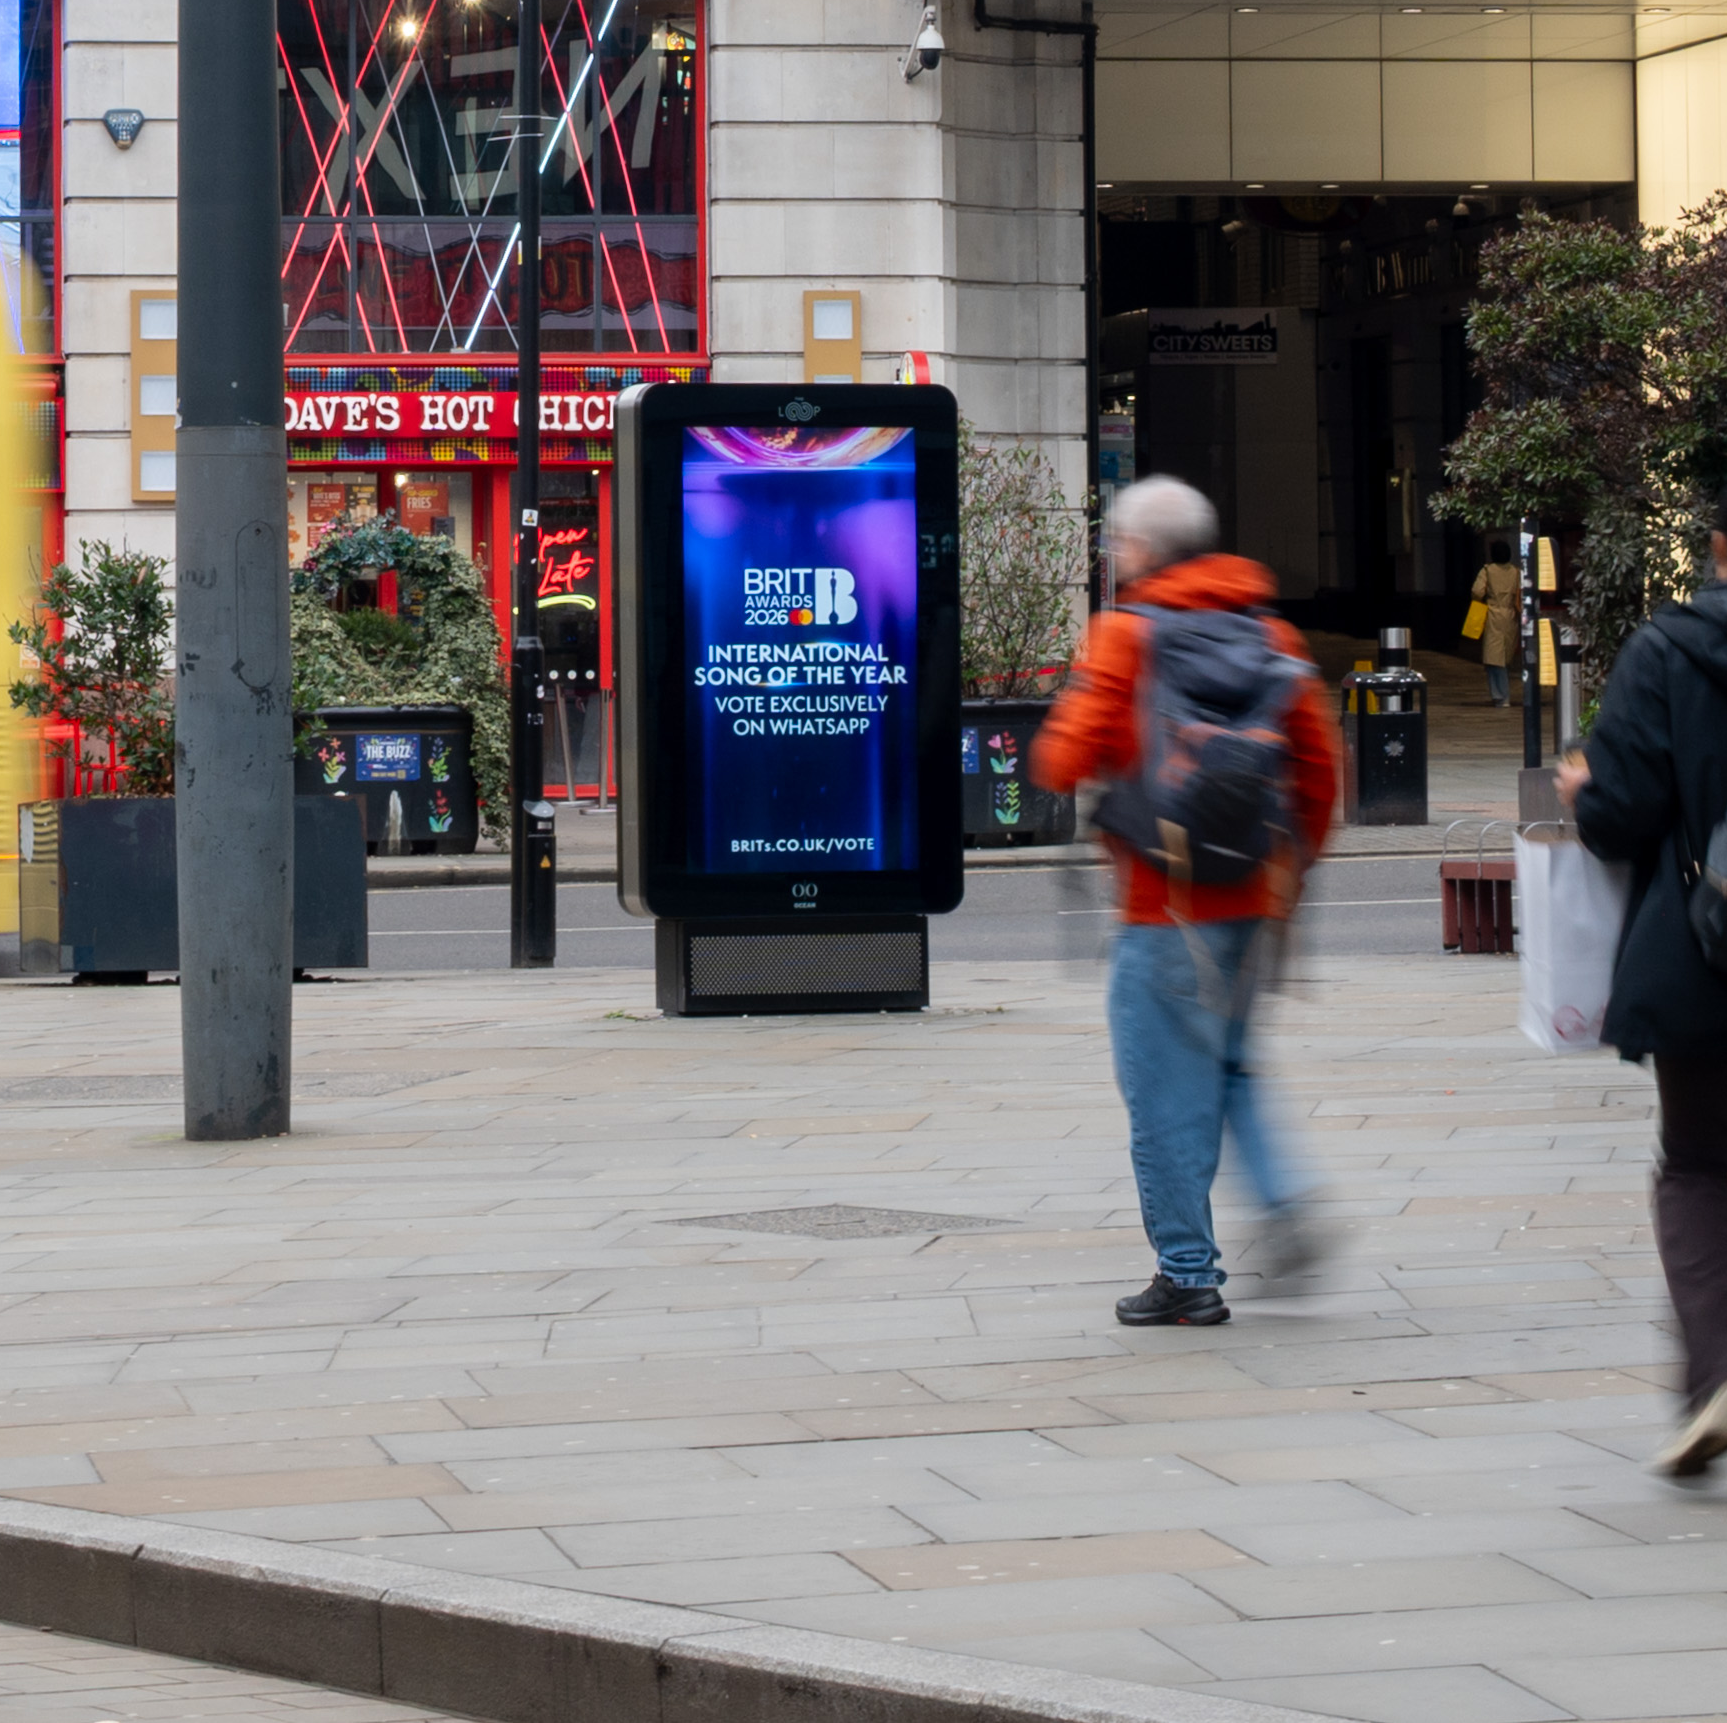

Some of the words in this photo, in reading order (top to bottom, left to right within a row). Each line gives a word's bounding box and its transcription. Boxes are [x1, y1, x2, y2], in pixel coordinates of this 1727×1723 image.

[1153, 335, 1196, 351] CITY
[1200, 334, 1273, 351] SWEETS
[284, 393, 401, 432] DAVE'S
[420, 395, 494, 431] HOT
[406, 496, 433, 509] FRIES
[537, 549, 595, 598] Late
[744, 567, 813, 595] BRIT
[744, 595, 814, 608] AWARDS
[744, 608, 789, 625] 2026
[708, 643, 889, 663] INTERNATIONAL
[694, 666, 762, 686] SONG
[767, 666, 798, 686] OF
[803, 666, 846, 685] THE
[850, 665, 908, 685] YEAR
[715, 696, 765, 713] VOTE
[770, 694, 889, 713] EXCLUSIVELY
[733, 719, 765, 736] ON
[769, 718, 870, 735] WHATSAPP
[366, 745, 384, 758] THE
[386, 745, 411, 758] BUZZ
[730, 837, 875, 854] BRITs.CO.UK/VOTE
